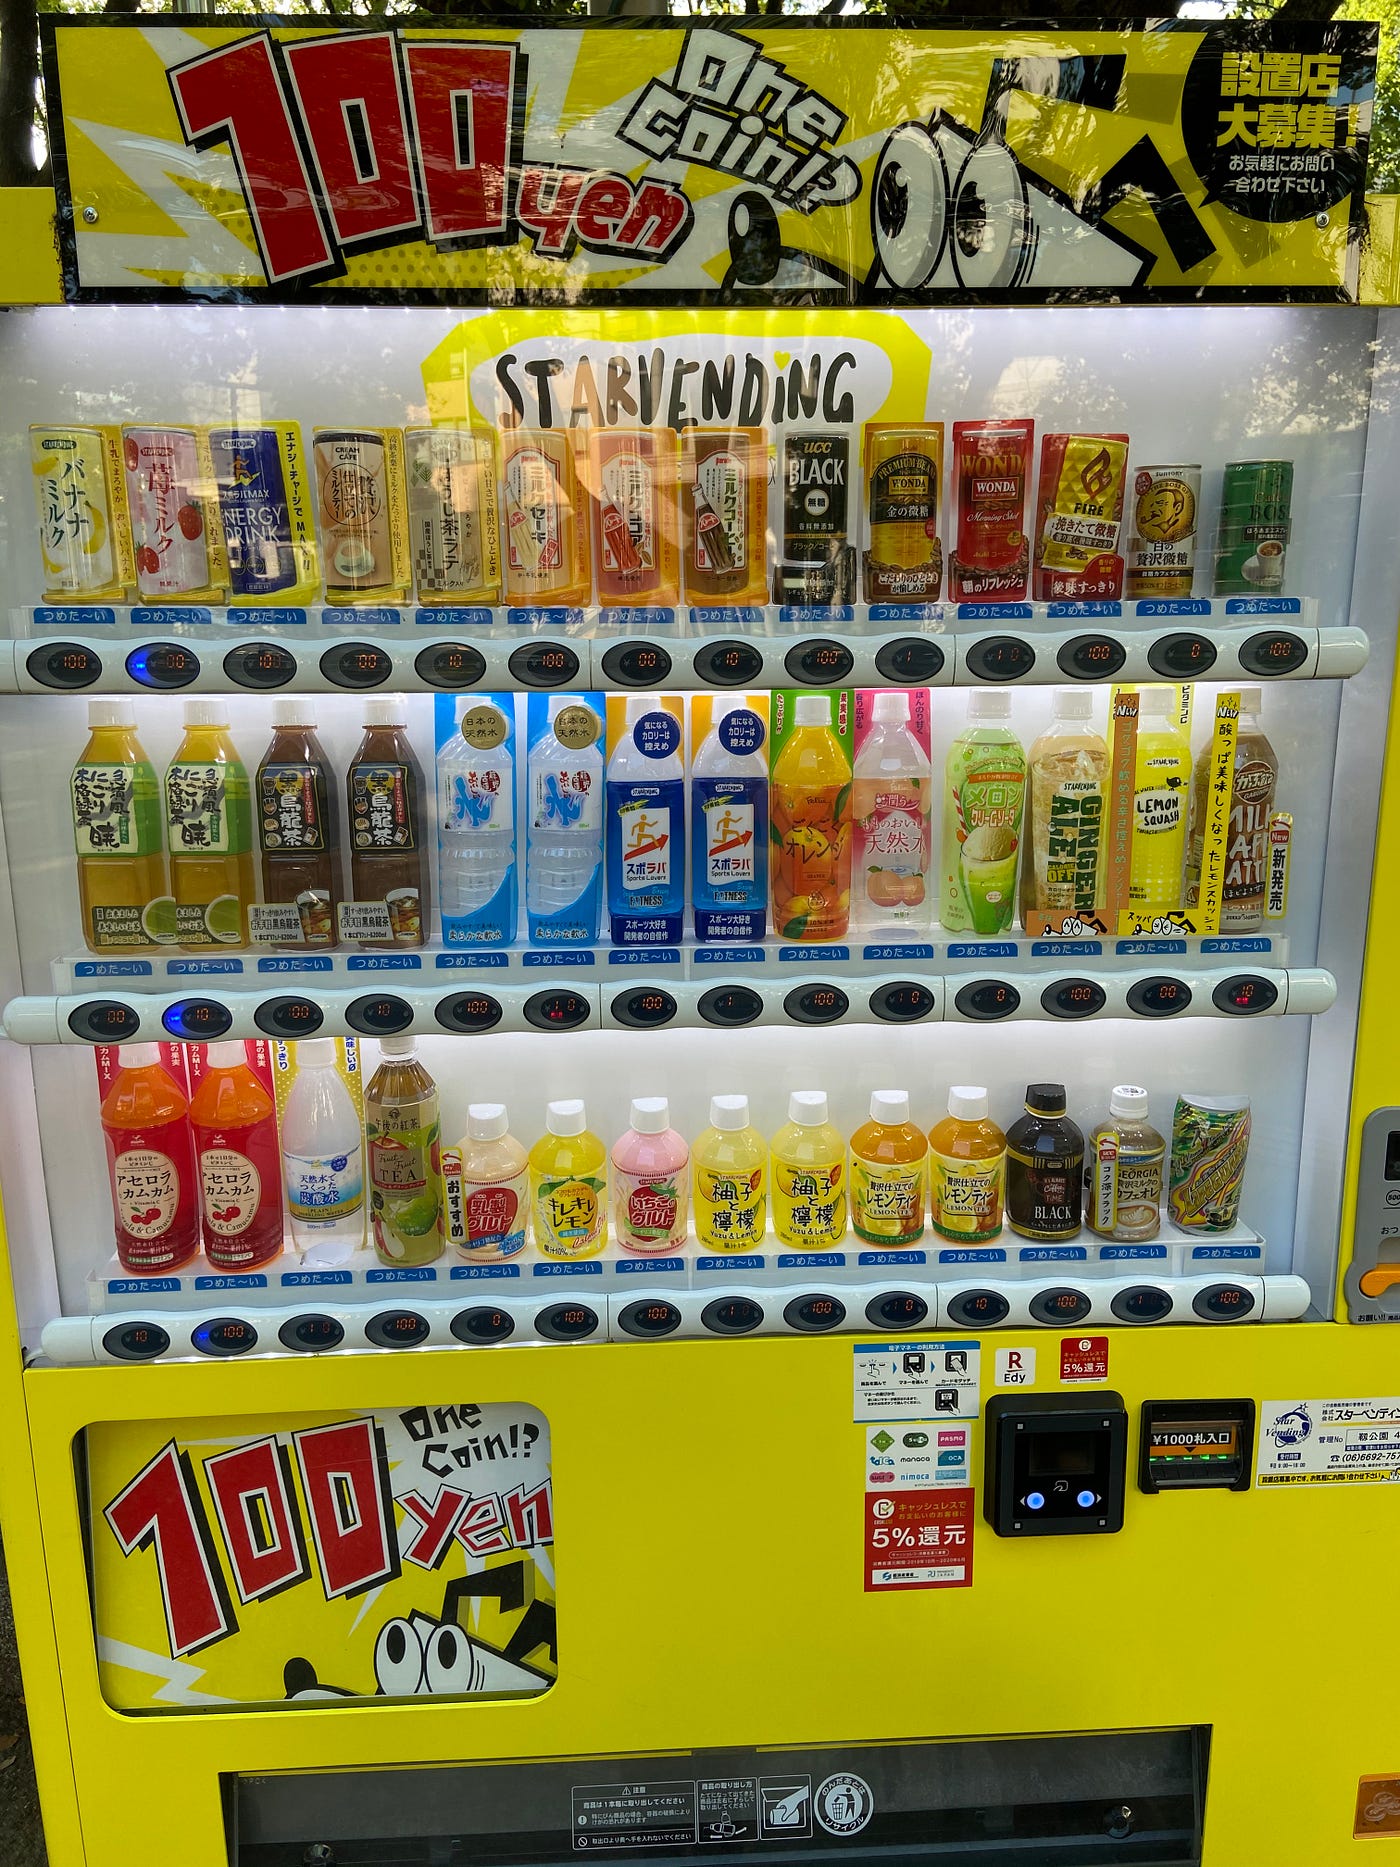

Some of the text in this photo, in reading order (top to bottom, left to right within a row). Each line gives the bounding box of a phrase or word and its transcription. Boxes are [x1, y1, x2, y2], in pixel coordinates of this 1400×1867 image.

[1221, 52, 1341, 97] 設置店
[676, 28, 847, 145] One
[166, 30, 690, 284] 100 yen
[1229, 155, 1335, 172] お気軽にお問い
[1235, 177, 1325, 193] 合わせ下さい
[789, 459, 844, 485] BLACK
[892, 478, 926, 488] WONDA
[976, 481, 1016, 493] WONDA
[61, 458, 89, 537] バナナ
[332, 470, 341, 518] ミルクティー
[145, 462, 175, 554] 苺ミルク
[808, 498, 826, 507] 無糖
[1074, 503, 1104, 516] FIRE
[47, 479, 65, 548] ミルク
[887, 505, 929, 517] 金の微糖
[226, 525, 280, 544] DRINK
[1054, 517, 1118, 539] 挽きたて微糖
[1153, 543, 1174, 552] 白の
[1136, 552, 1188, 567] 贅沢微糖
[879, 573, 938, 584] こだわりのひととき
[963, 576, 1024, 594] 朝のリフレッシュ
[1053, 581, 1115, 595] 後味すっきり
[915, 692, 925, 734] ほんのり甘く
[466, 717, 496, 727] 日本の
[559, 717, 588, 726] 日本の
[644, 721, 668, 730] 気になる
[731, 717, 754, 727] 気になる
[465, 727, 498, 738] 天然水
[558, 727, 590, 738] 天然水
[642, 731, 671, 741] カロリーは
[728, 727, 756, 738] カロリーは
[645, 741, 669, 750] 控えめ
[730, 737, 754, 748] 控えめ
[966, 786, 1022, 808] メロン
[1137, 797, 1179, 813] LEMON
[279, 794, 302, 846] 烏龍茶
[371, 794, 394, 846] 烏龍茶
[971, 809, 1015, 827] クリームソーダ
[1144, 811, 1179, 826] SQUASH
[792, 818, 840, 834] ごくごく
[1048, 795, 1080, 857] ALE
[1271, 832, 1289, 842] New
[786, 838, 844, 864] オレンジ
[1075, 796, 1103, 909] GINGER
[627, 862, 666, 875] スポラバ
[712, 859, 751, 870] スポラバ
[1048, 870, 1075, 882] OFF
[1270, 848, 1286, 911] 新発売
[626, 920, 666, 930] スポーツ大好き
[710, 915, 750, 924] スポーツ大好き
[624, 931, 668, 941] 開発者の自信作
[708, 926, 752, 935] 開発者の自信作
[376, 1118, 418, 1131] 午後の紅茶
[117, 1170, 172, 1187] アセロラ
[300, 1173, 337, 1184] 天然水で
[380, 1169, 417, 1183] TEA
[947, 1177, 990, 1187] 贅沢仕立ての
[123, 1185, 174, 1200] カムカム
[205, 1185, 255, 1196] カムカム
[300, 1183, 337, 1191] つくった
[713, 1182, 752, 1201] 柚子
[791, 1177, 831, 1198] 柚子
[870, 1181, 914, 1192] 贅沢仕立ての
[300, 1190, 339, 1205] 炭酸水
[631, 1195, 676, 1210] いちごの
[807, 1196, 819, 1207] と
[447, 1180, 464, 1237] おすすめ
[548, 1197, 595, 1215] キレキレ
[728, 1201, 739, 1212] と
[1035, 1206, 1072, 1220] BLACK
[553, 1211, 594, 1228] レモン
[631, 1209, 675, 1227] グルト
[712, 1209, 755, 1232] 檸檬
[791, 1204, 834, 1228] 檸檬
[468, 1216, 513, 1231] グルト
[789, 1226, 836, 1235] Yuzu Lemon
[710, 1230, 757, 1239] Yuzu Lemon
[1008, 1351, 1023, 1369] R
[1063, 1363, 1106, 1374] 5%還元
[1004, 1372, 1026, 1384] Edy
[399, 1404, 483, 1442] One
[1273, 1416, 1296, 1426] Star
[1152, 1432, 1230, 1446] ¥1000札入口
[1265, 1428, 1306, 1438] Vending
[421, 1423, 540, 1479] Coin!?
[898, 1501, 967, 1511] キャッシュレスで
[898, 1511, 967, 1520] お支払いのお客様に
[103, 1415, 400, 1660] 100
[872, 1525, 966, 1548] 5%還元
[632, 1786, 646, 1794] 注意
[821, 1777, 867, 1797] のんだあとは
[825, 1815, 865, 1832] リサイクル
